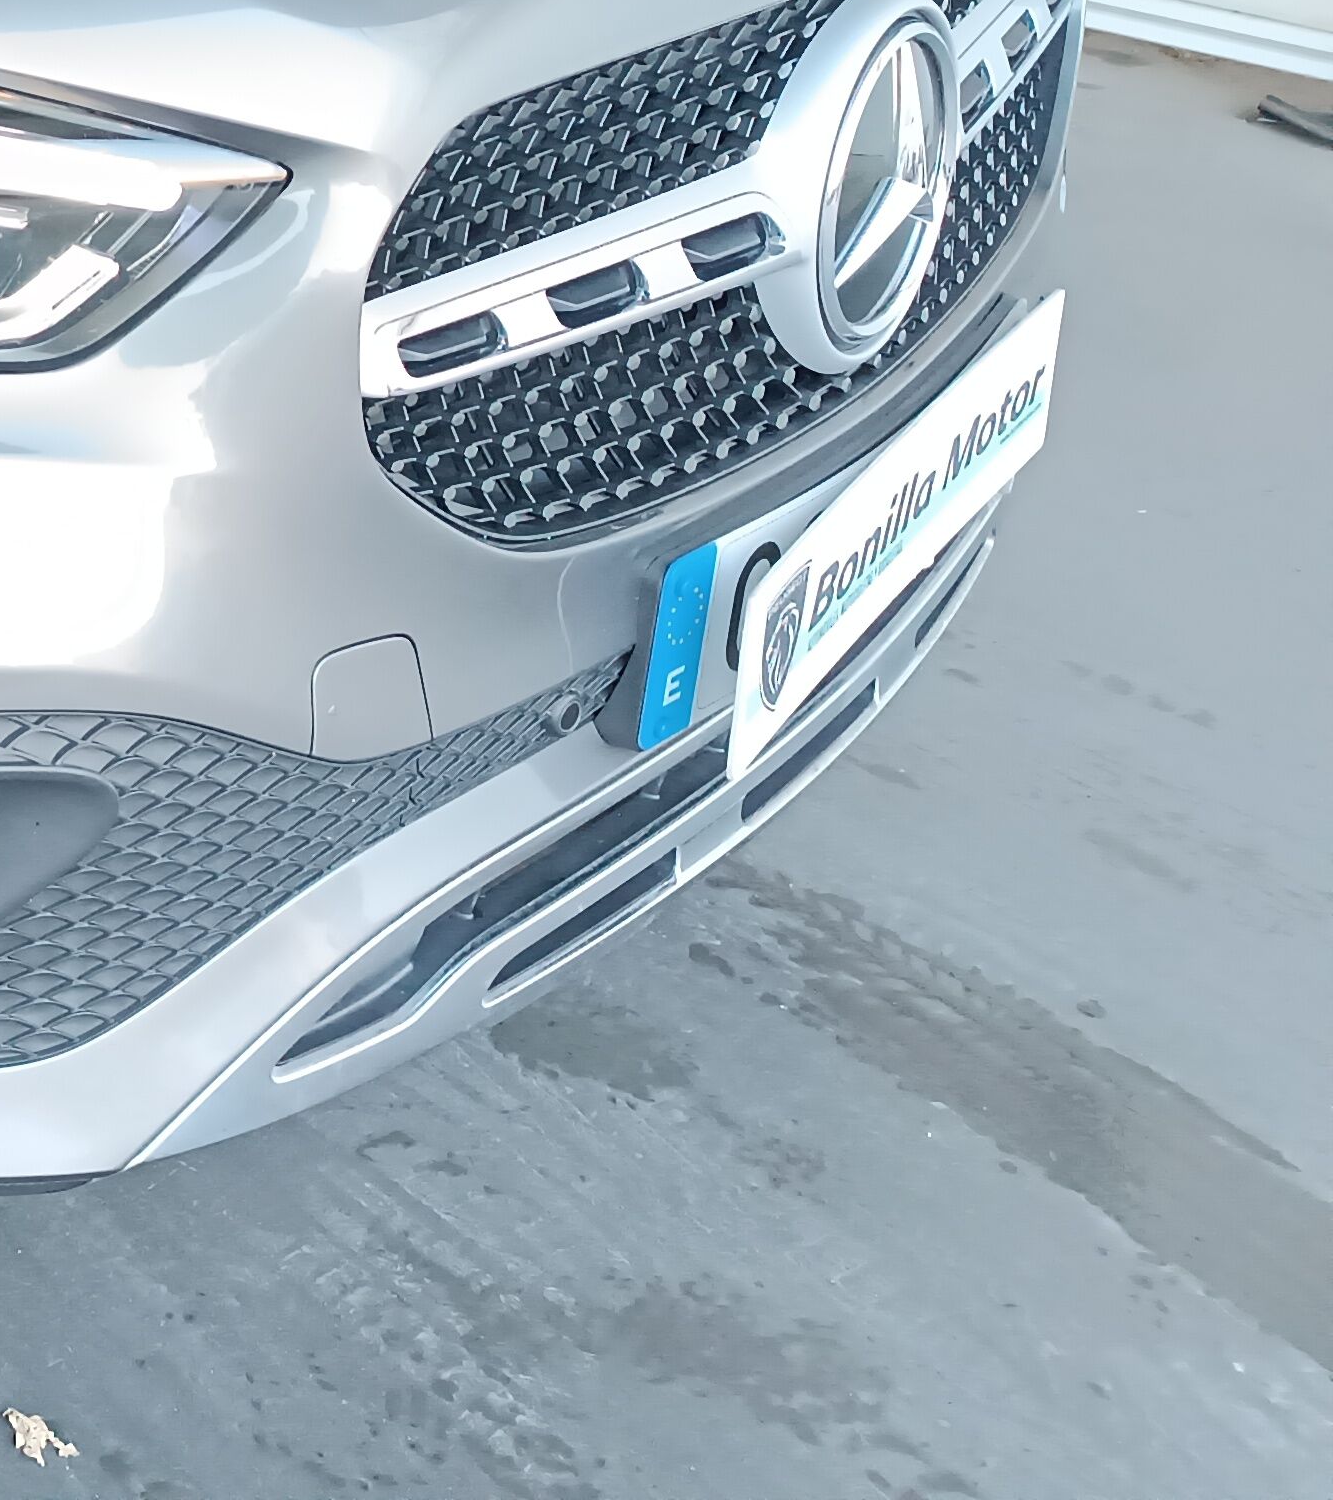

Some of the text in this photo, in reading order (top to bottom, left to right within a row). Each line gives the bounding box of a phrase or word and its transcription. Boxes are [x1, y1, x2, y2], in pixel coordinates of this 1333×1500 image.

[808, 469, 936, 632] Bonilla
[942, 364, 1046, 490] Motor
[663, 665, 685, 706] E
